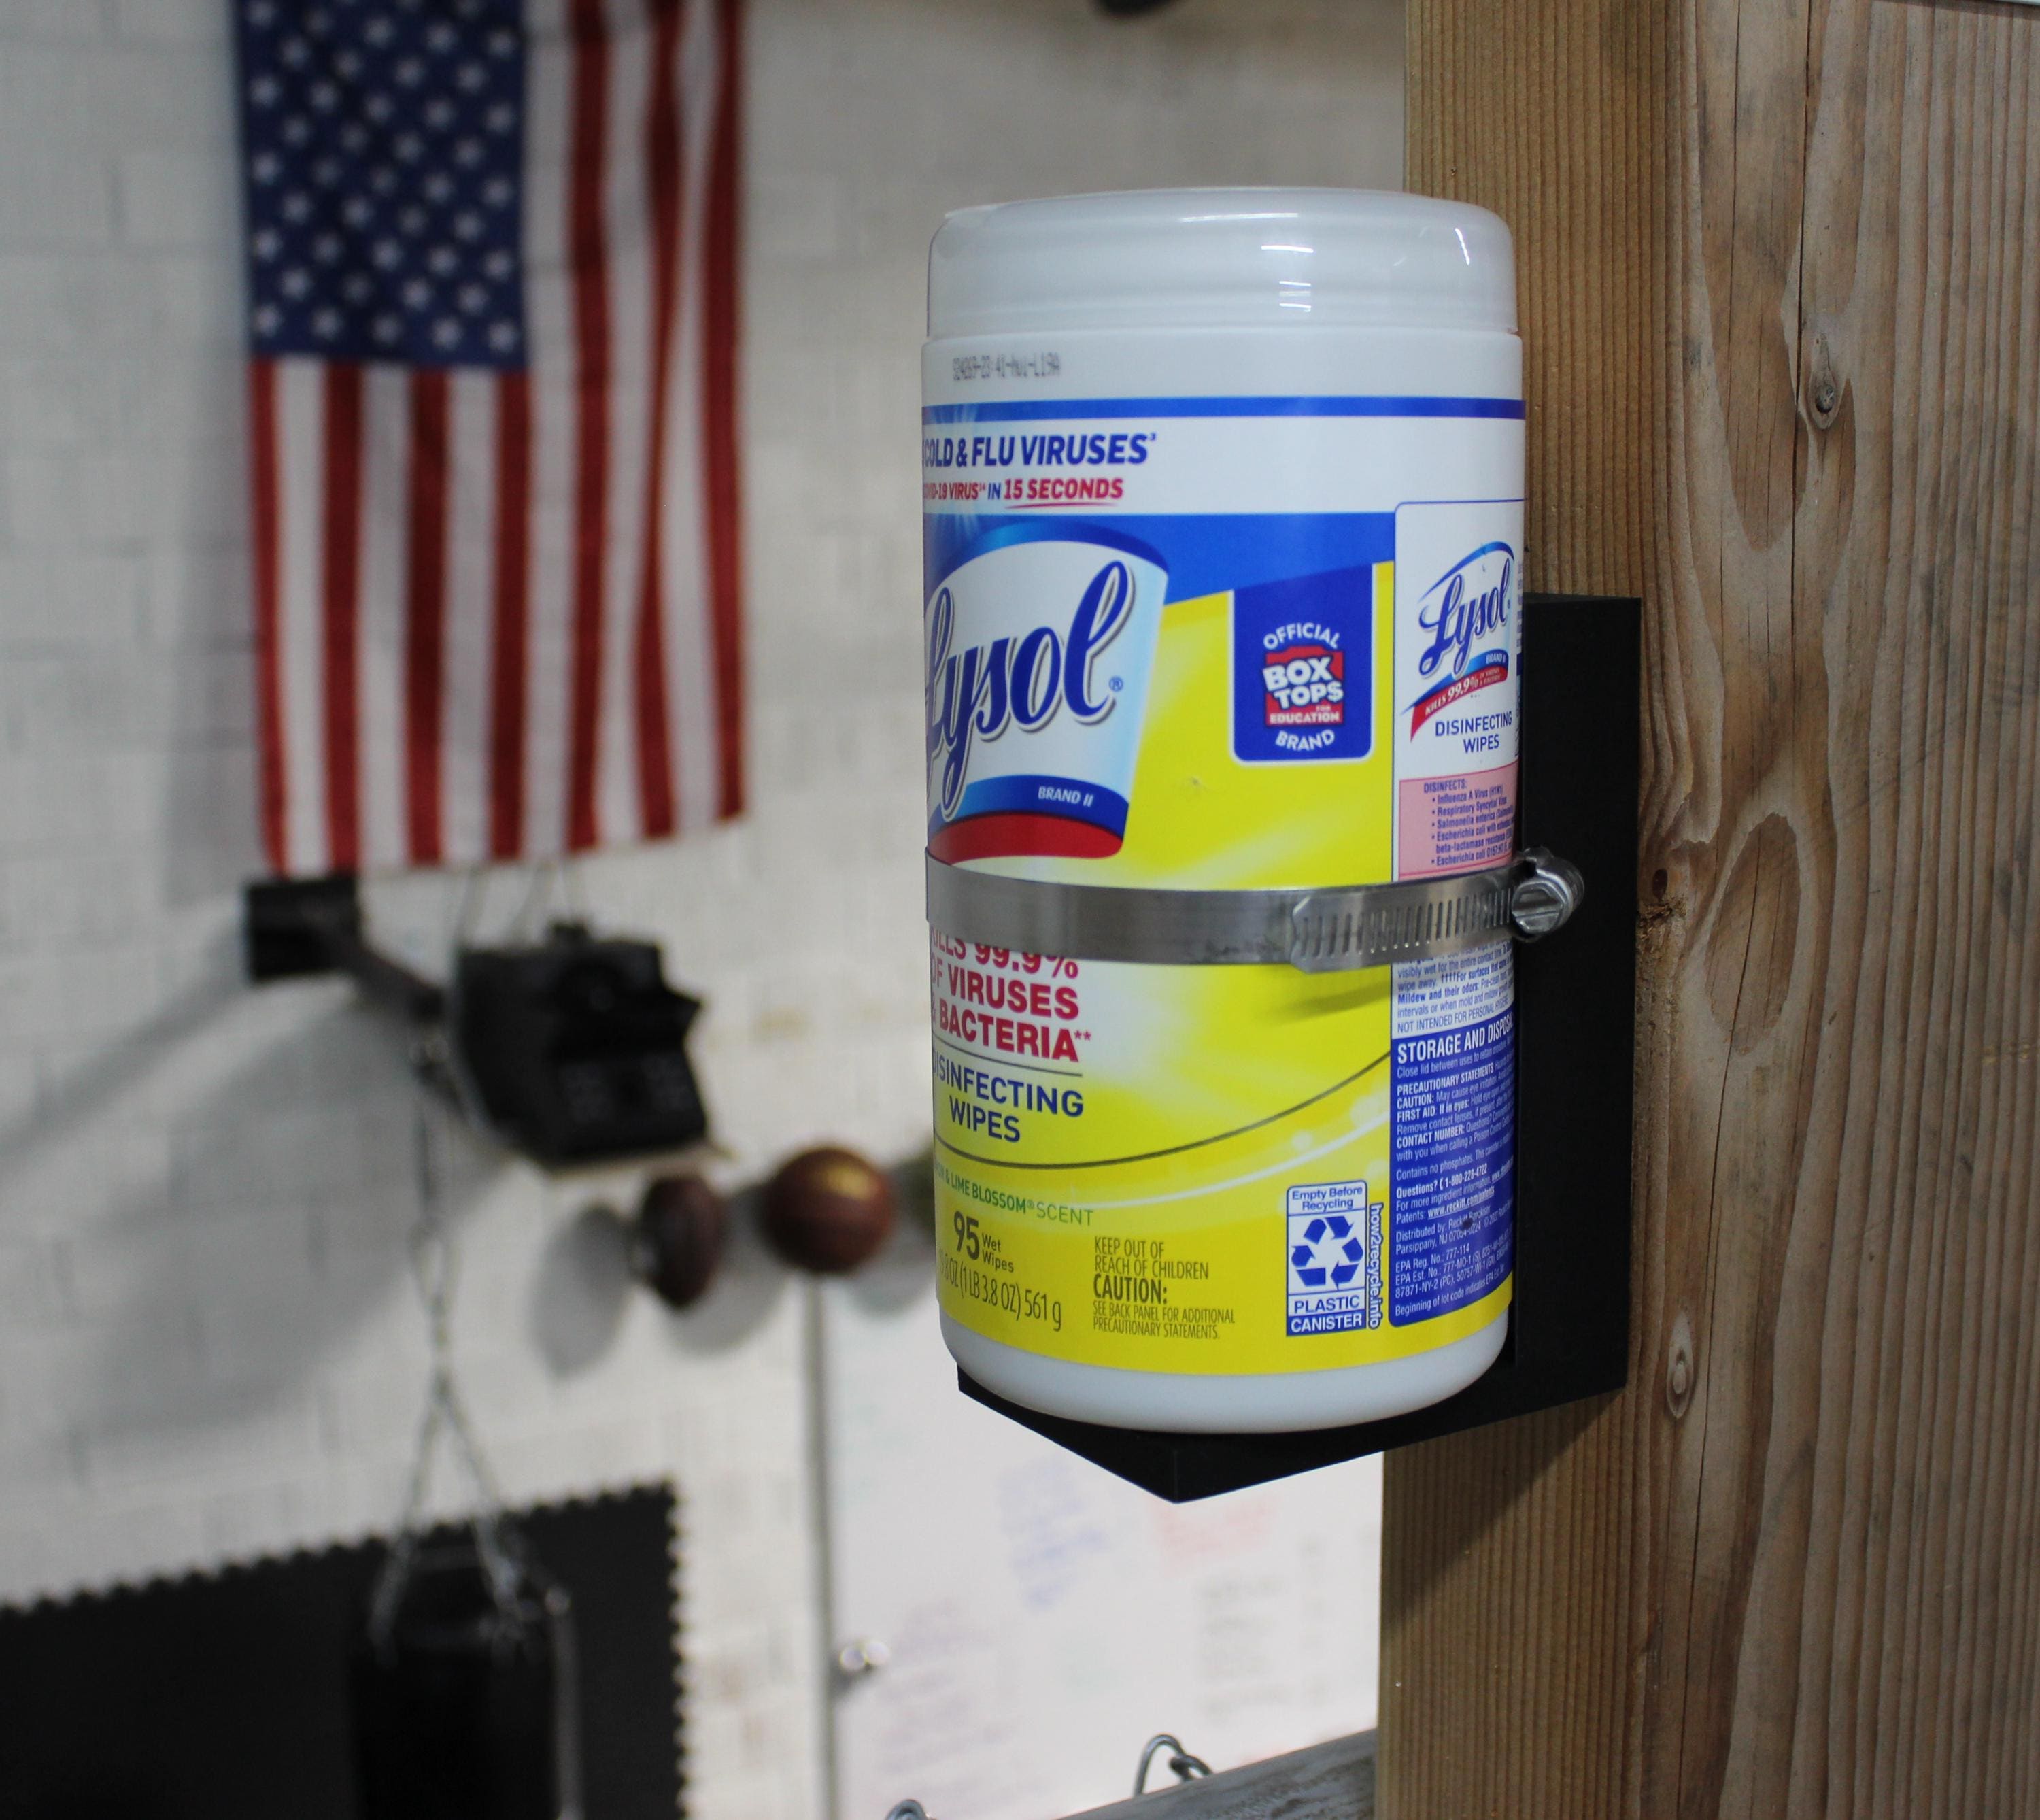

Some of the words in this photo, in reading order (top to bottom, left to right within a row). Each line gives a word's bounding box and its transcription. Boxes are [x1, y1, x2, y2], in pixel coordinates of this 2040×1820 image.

[956, 437, 968, 468] &
[972, 435, 1015, 467] FLU
[988, 482, 1002, 500] IN
[1004, 478, 1023, 500] 15
[1027, 477, 1123, 500] SECONDS
[1418, 558, 1510, 677] Lysol
[1263, 622, 1340, 650] OFFICIAL
[1262, 656, 1334, 692] BOX
[1273, 680, 1344, 710] TOPS
[1425, 696, 1447, 716] KILLS
[1269, 711, 1340, 724] EDUCATION
[1435, 711, 1512, 737] DISINFECTING
[1275, 729, 1336, 752] BRAND
[1463, 734, 1499, 754] WIPES
[1038, 785, 1081, 805] BRAND
[1083, 793, 1094, 807] II
[1438, 793, 1467, 805] Influenza
[1468, 791, 1473, 801] A
[1474, 788, 1489, 799] Virus
[1437, 803, 1475, 818] Respiratory
[1437, 815, 1474, 830] Salmonella
[1437, 826, 1474, 842] Escherichia
[1435, 838, 1484, 854] beta-lactamase
[1436, 851, 1474, 866] Escherichia
[1398, 966, 1421, 979] visibly
[1424, 964, 1436, 975] wet
[1438, 962, 1447, 973] for
[1448, 960, 1459, 970] the
[1468, 966, 1490, 979] surfaces
[947, 962, 1079, 1021] VIRUSES
[1398, 992, 1426, 1005] Mildew
[1429, 989, 1442, 1000] and
[1445, 985, 1460, 997] their
[1398, 1005, 1428, 1018] intervals
[1430, 1003, 1438, 1013] or
[1440, 1000, 1457, 1012] when
[1458, 996, 1473, 1007] mold
[1397, 1021, 1414, 1034] NOT
[1416, 1013, 1453, 1030] INTENDED
[1455, 1011, 1467, 1024] FOR
[1397, 1033, 1461, 1064] STORAGE
[1463, 1026, 1485, 1052] AND
[1397, 1066, 1418, 1079] Close
[1431, 1058, 1458, 1072] between
[1397, 1074, 1459, 1096] PRECAUTIONARY
[1460, 1062, 1494, 1083] STATEMENTS
[1397, 1094, 1434, 1110] CAUTION:
[1436, 1090, 1450, 1105] May
[1452, 1086, 1469, 1098] cause
[949, 1094, 1021, 1143] WIPES
[1397, 1108, 1421, 1123] FIRST
[1446, 1102, 1452, 1113] in
[1397, 1123, 1427, 1136] Remove
[1429, 1117, 1453, 1129] contact
[1397, 1133, 1432, 1149] CONTACT
[1434, 1124, 1465, 1142] NUMBER:
[1396, 1149, 1413, 1162] with
[1414, 1149, 1429, 1162] you
[1430, 1143, 1448, 1156] when
[1396, 1168, 1428, 1181] Contains
[1429, 1165, 1439, 1175] no
[951, 1170, 970, 1196] LIME
[1036, 1201, 1094, 1226] SCENT
[1292, 1190, 1327, 1202] Empty
[1329, 1185, 1363, 1198] Before
[1396, 1180, 1438, 1200] Questions?
[1396, 1200, 1410, 1211] For
[1411, 1197, 1429, 1209] more
[1431, 1187, 1463, 1207] ingredient
[1302, 1198, 1354, 1213] Recycling
[1396, 1211, 1426, 1225] Patents:
[953, 1210, 980, 1260] 95
[982, 1232, 1002, 1253] Wet
[1396, 1224, 1435, 1243] Distributed
[1439, 1232, 1448, 1245] NJ
[1094, 1236, 1121, 1255] KEEP
[1123, 1239, 1146, 1258] OUT
[1150, 1241, 1165, 1259] OF
[1395, 1260, 1411, 1274] EPA
[1446, 1243, 1470, 1260] 777-114
[982, 1249, 1015, 1273] Wipes
[1094, 1254, 1129, 1275] REACH
[1134, 1258, 1148, 1277] OF
[1152, 1260, 1209, 1280] CHILDREN
[1367, 1202, 1383, 1329] how2recycle.info
[1093, 1273, 1168, 1304] CAUTION:
[1395, 1273, 1411, 1286] EPA
[1395, 1280, 1438, 1299] 87871-NY-2
[969, 1268, 980, 1299] LB
[983, 1274, 998, 1307] 3.8
[1000, 1282, 1021, 1322] OZ)
[1024, 1288, 1048, 1321] 561
[1052, 1300, 1061, 1332] g
[1294, 1294, 1360, 1314] PLASTIC
[1395, 1300, 1431, 1317] Beginning
[1433, 1296, 1440, 1307] of
[1441, 1292, 1449, 1303] lot
[1450, 1287, 1465, 1301] code
[1093, 1300, 1107, 1317] SEE
[1109, 1302, 1131, 1319] BACK
[1134, 1304, 1159, 1321] PANEL
[1162, 1307, 1179, 1321] FOR
[1182, 1308, 1236, 1324] ADDITIONAL
[1093, 1317, 1161, 1338] PRECAUTIONARY
[1163, 1323, 1221, 1340] STATEMENTS.
[1291, 1313, 1363, 1334] CANISTER
